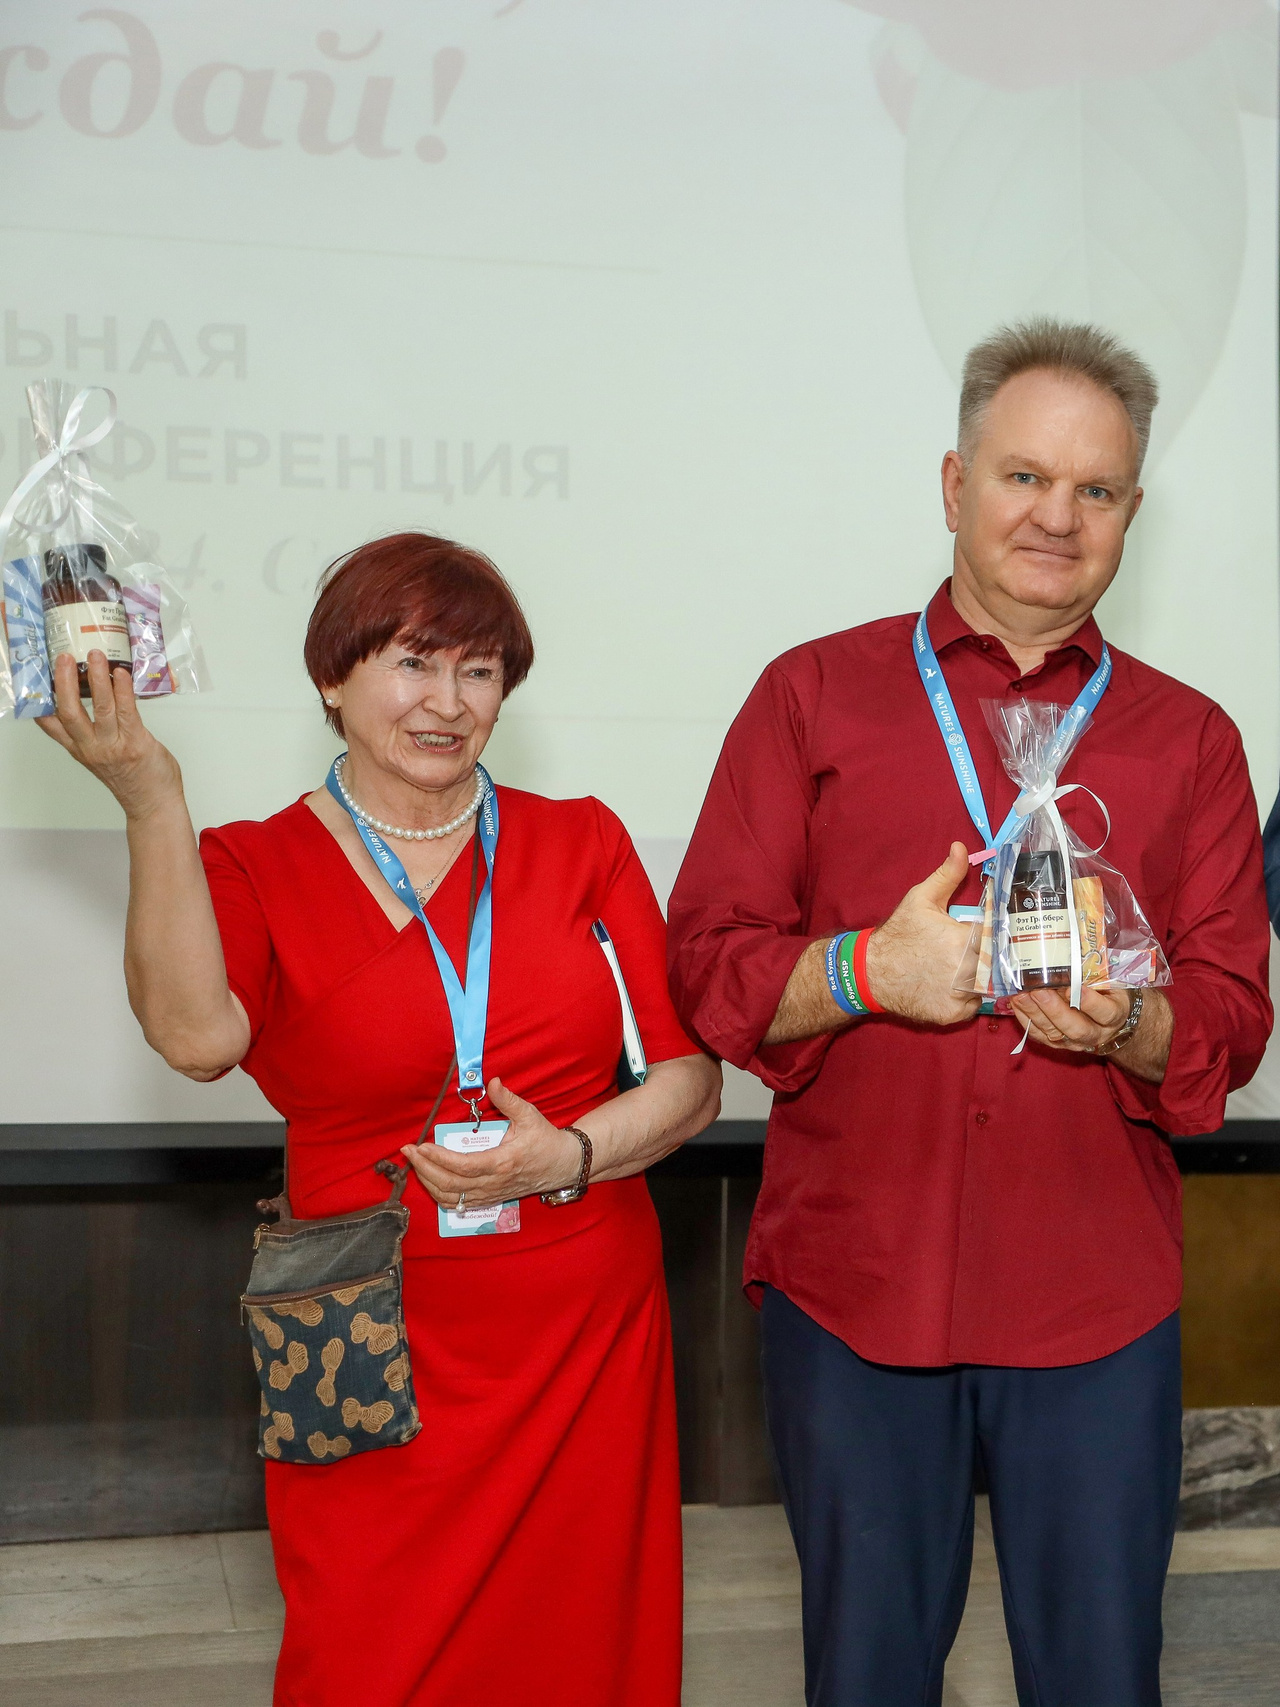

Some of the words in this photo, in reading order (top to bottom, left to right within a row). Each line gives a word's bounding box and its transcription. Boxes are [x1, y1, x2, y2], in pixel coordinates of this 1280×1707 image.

[4, 309, 250, 381] ЬНАЯ
[0, 416, 571, 504] ФЕРЕНЦИЯ
[1090, 662, 1110, 695] NATURES
[935, 692, 955, 732] NATURES
[953, 746, 975, 794] SUNSHINE
[483, 800, 495, 837] SUNSHINE
[1025, 923, 1052, 931] Grabers
